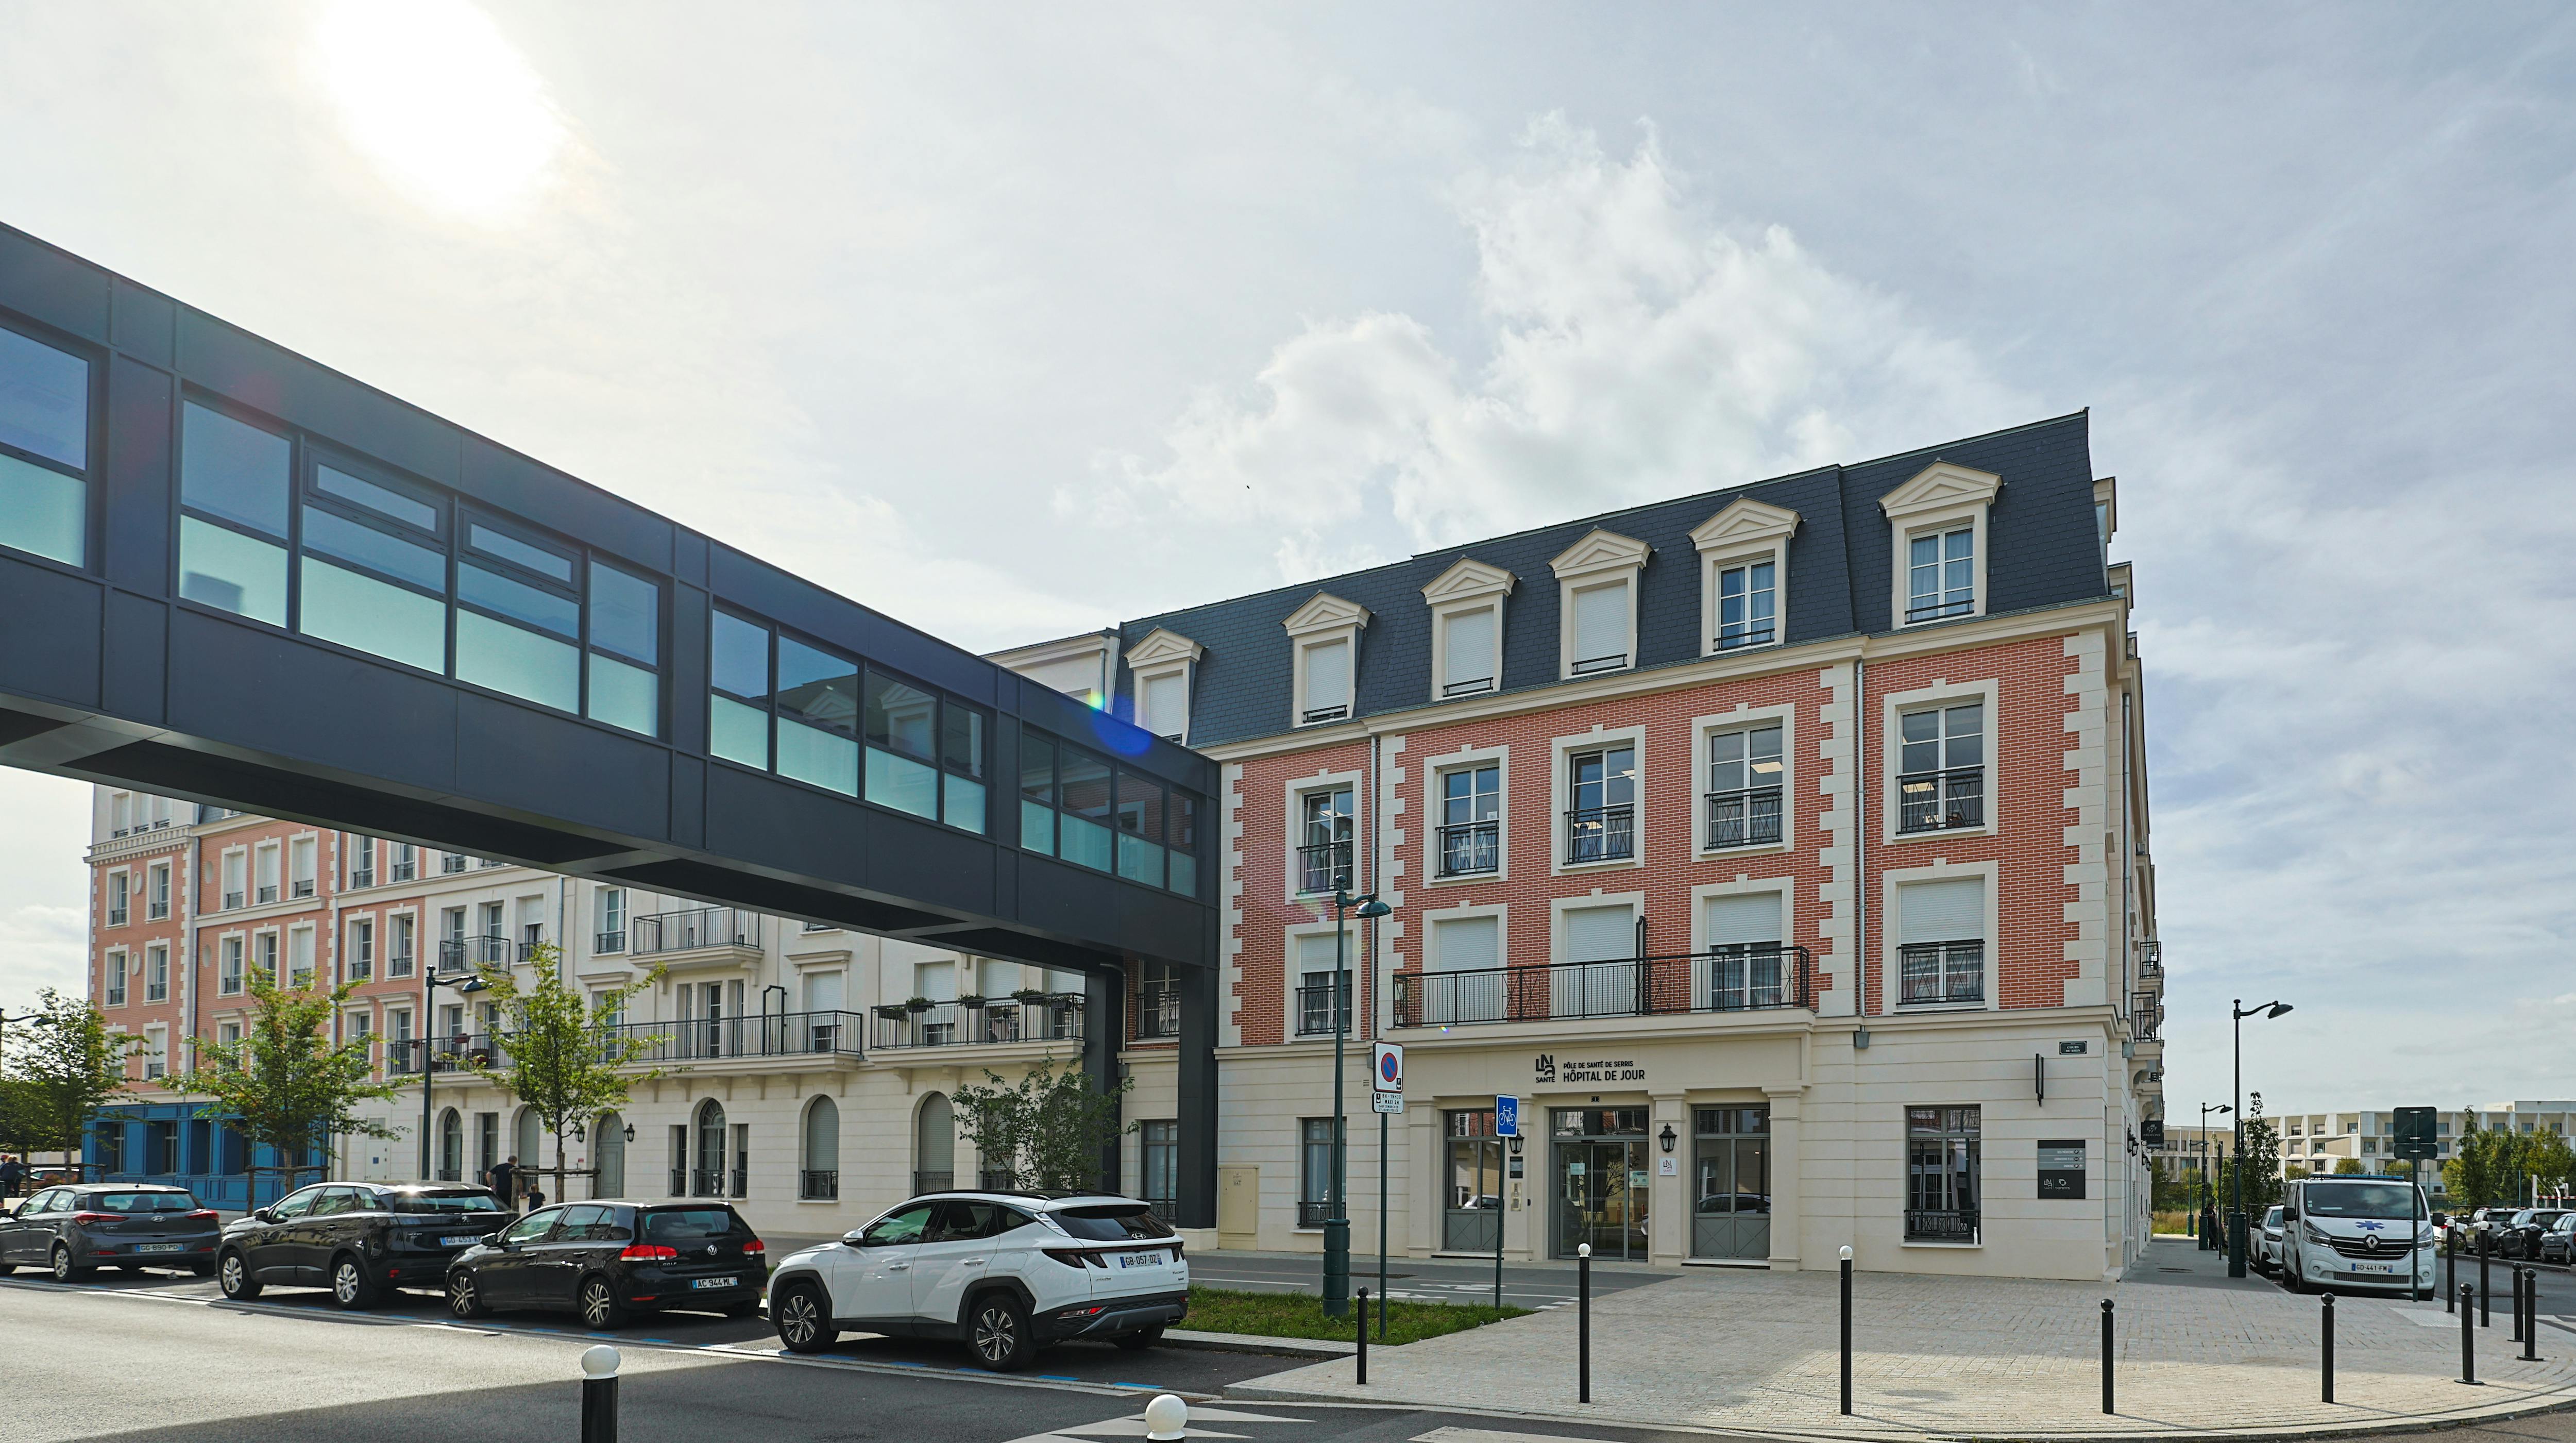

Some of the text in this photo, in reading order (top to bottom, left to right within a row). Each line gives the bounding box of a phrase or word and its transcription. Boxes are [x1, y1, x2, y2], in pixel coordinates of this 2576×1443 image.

[1563, 1069, 1645, 1082] HÔPITAL DE JOUR
[1125, 1254, 1158, 1266] GB-057-DZ
[698, 1279, 733, 1287] AC-944-ML
